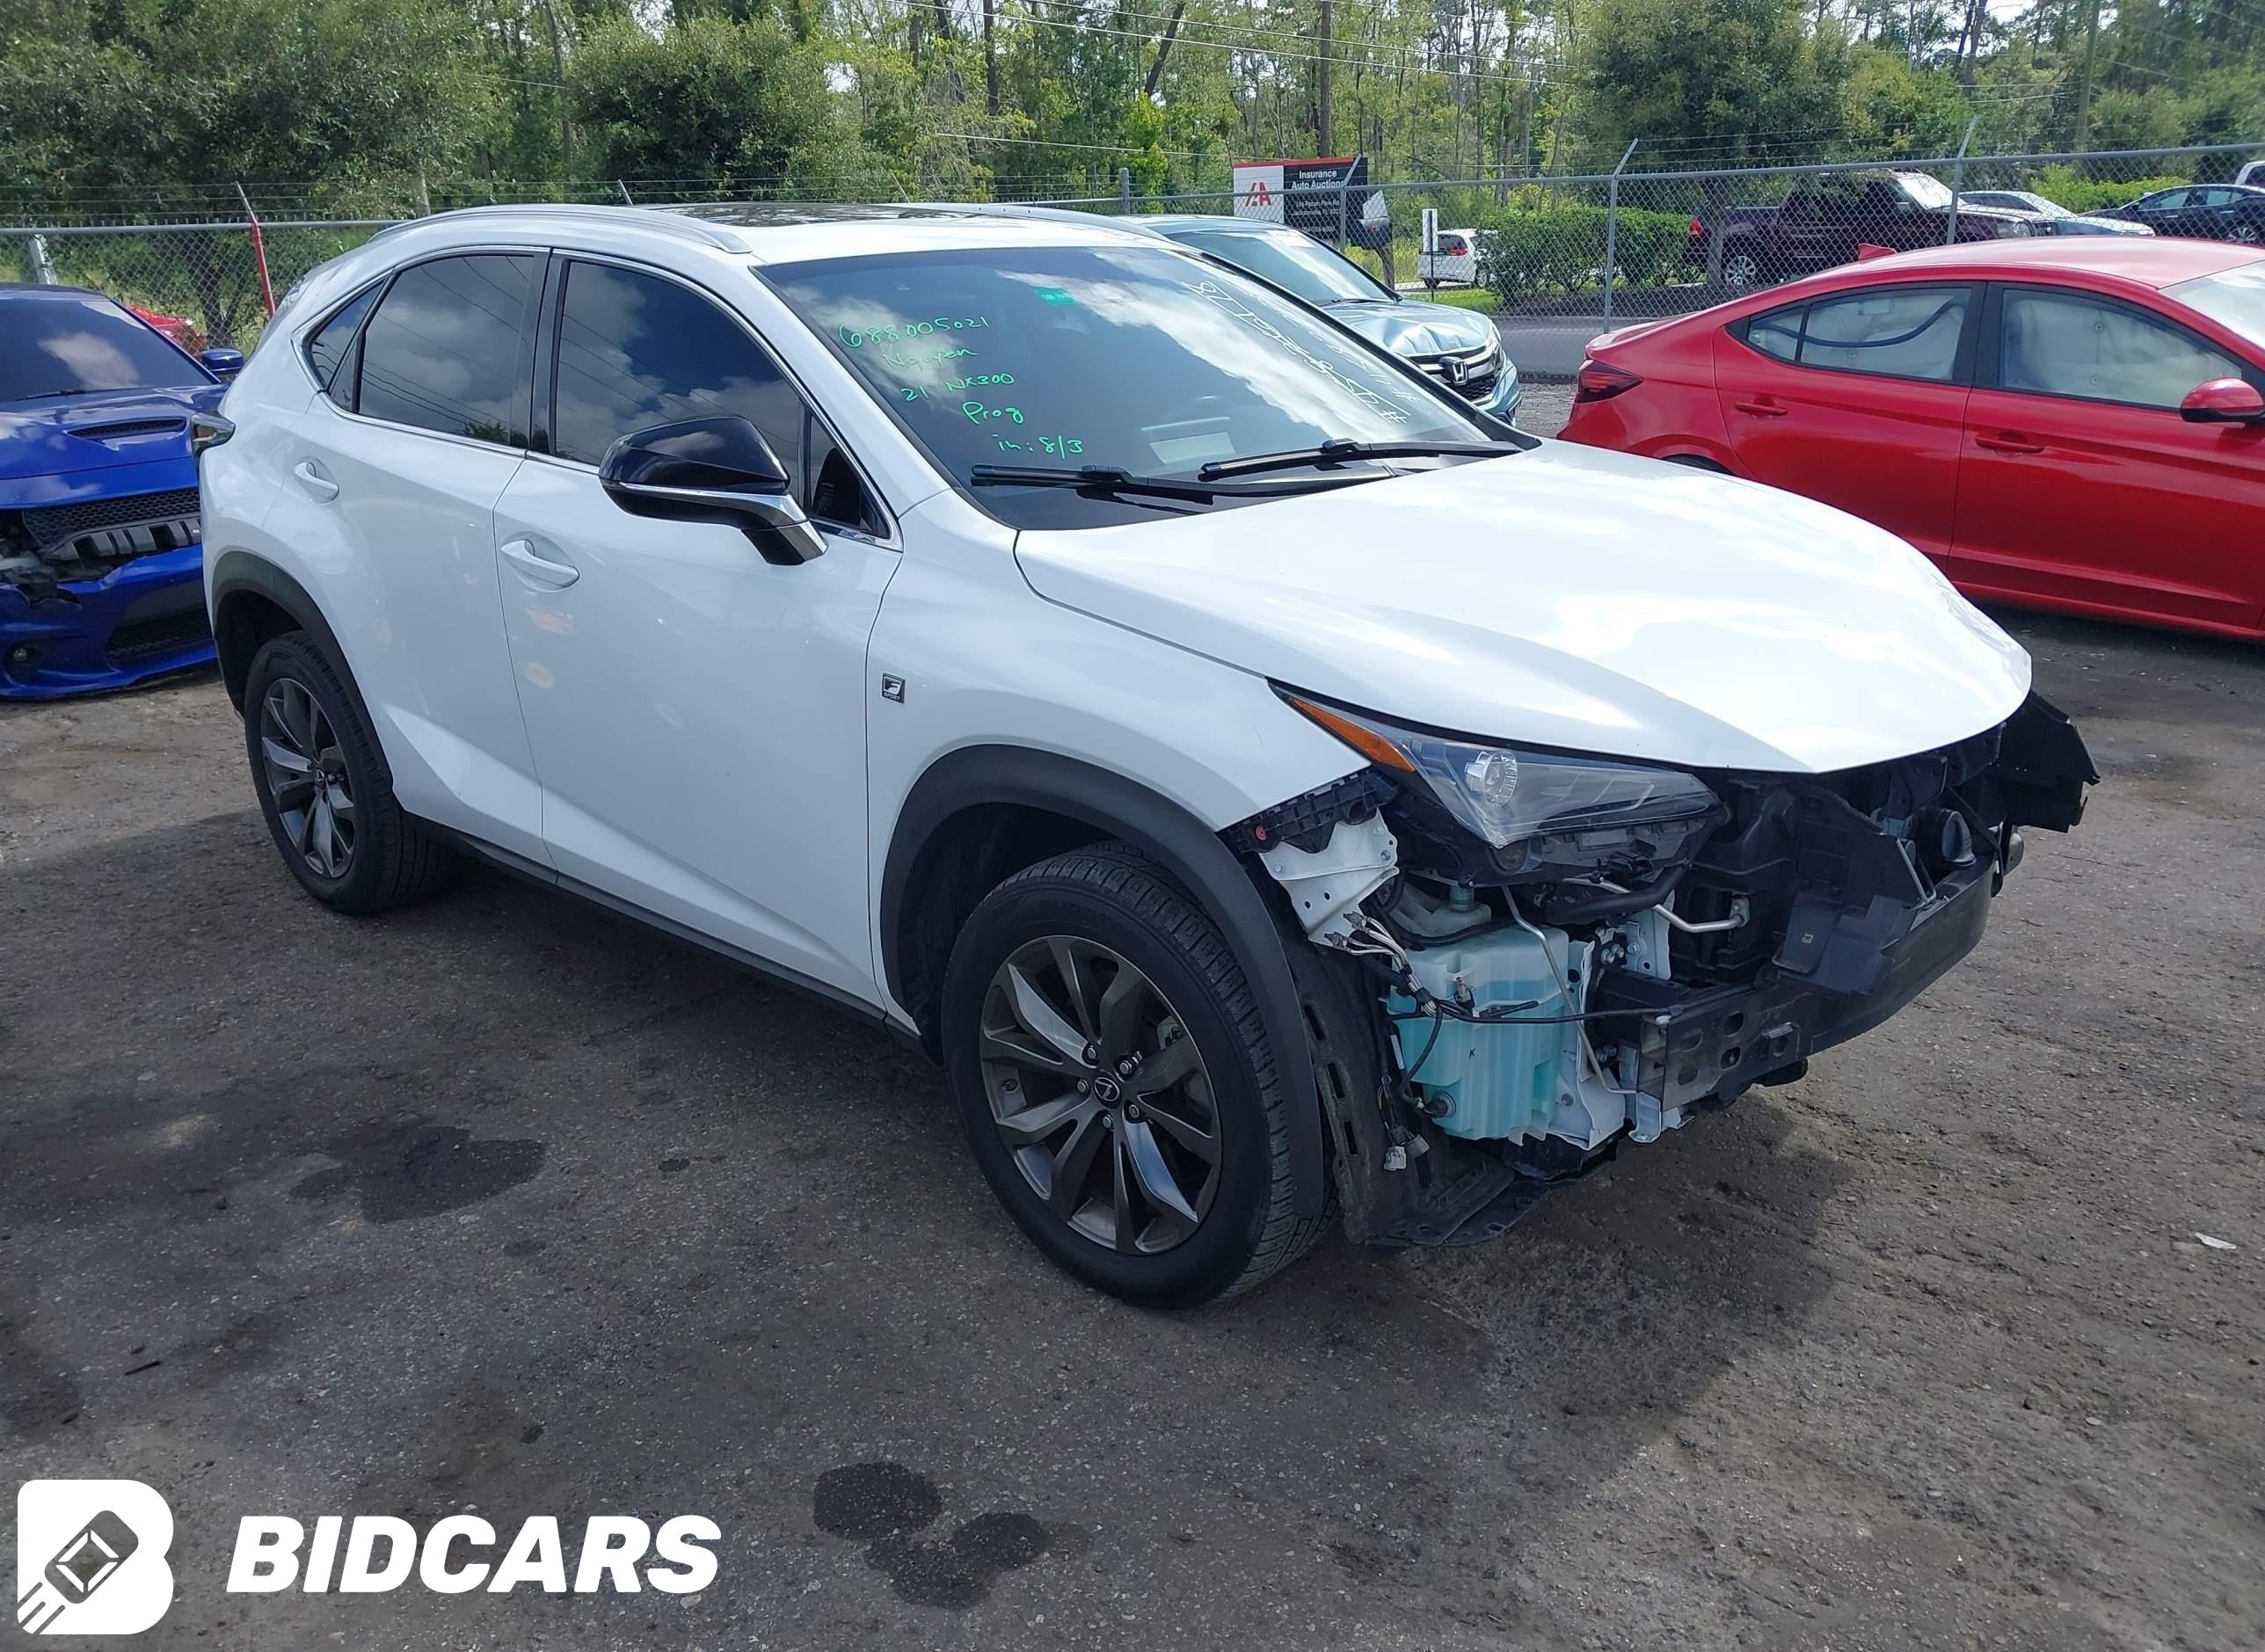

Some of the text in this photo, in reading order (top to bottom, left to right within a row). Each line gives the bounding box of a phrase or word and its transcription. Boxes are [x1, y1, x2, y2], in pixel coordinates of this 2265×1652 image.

[1299, 170, 1337, 179] Insurance
[1292, 181, 1309, 190] Auto
[900, 373, 1016, 402] 21 NX300
[1039, 434, 1084, 460] 8/3
